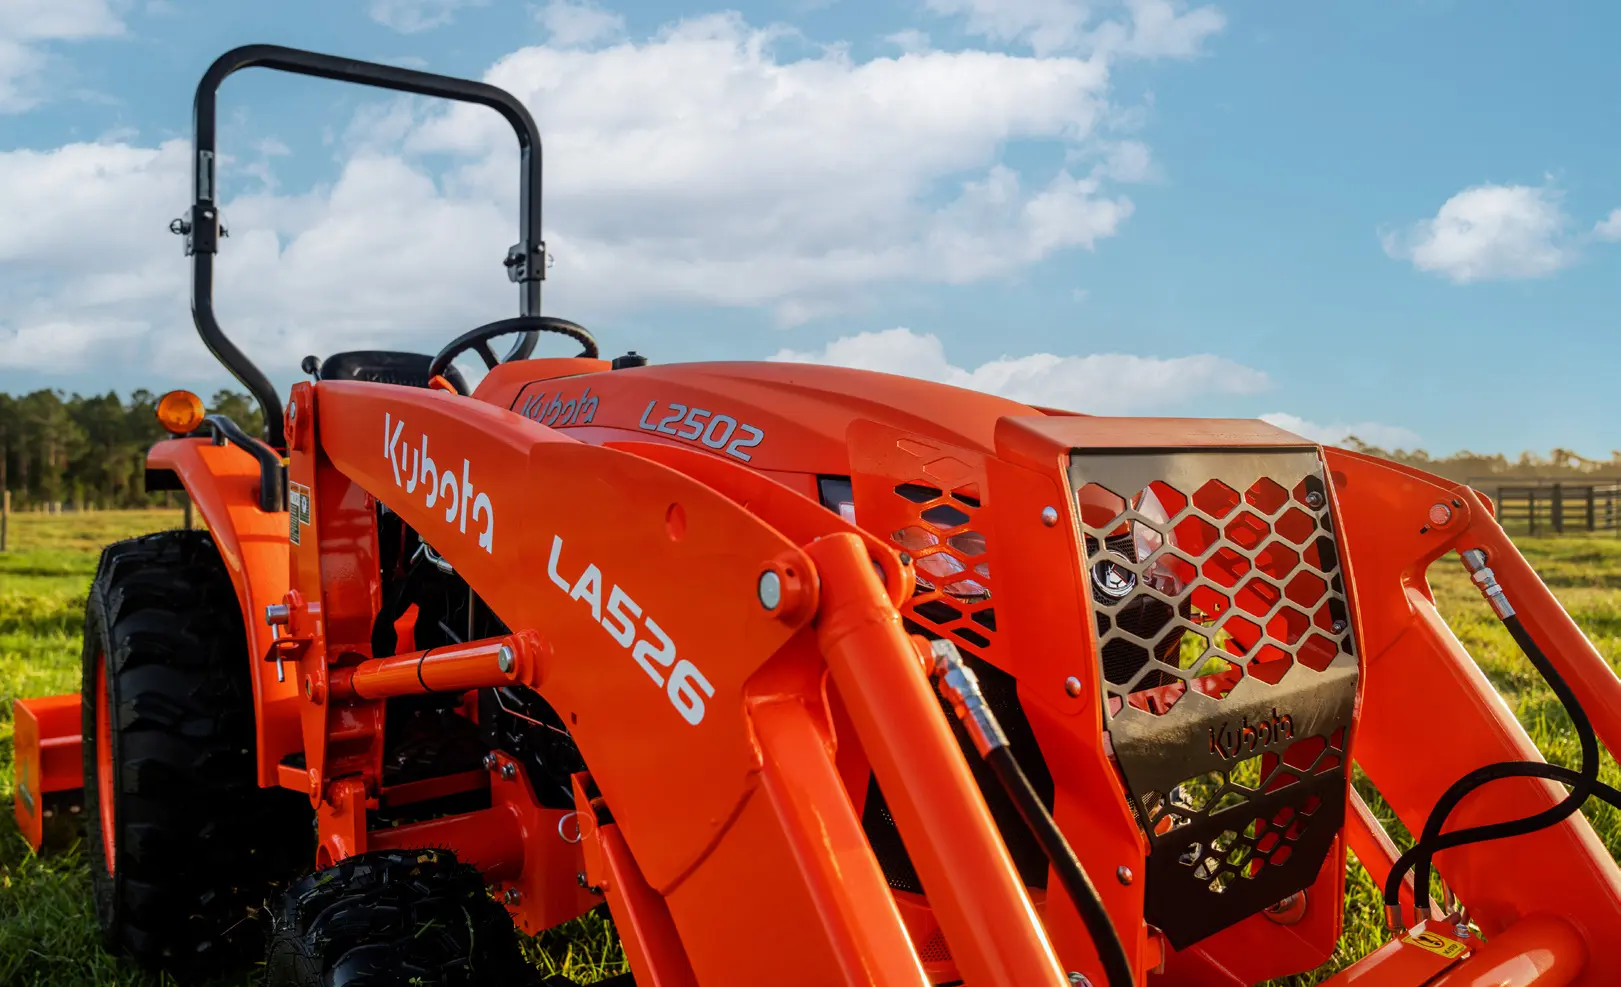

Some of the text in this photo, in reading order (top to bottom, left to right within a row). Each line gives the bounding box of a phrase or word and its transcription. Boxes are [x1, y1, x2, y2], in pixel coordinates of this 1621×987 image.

[520, 387, 599, 426] Kubota
[638, 400, 764, 462] L2502
[384, 412, 494, 554] Kubota
[547, 535, 715, 726] LA526
[1208, 707, 1294, 760] Kubota
